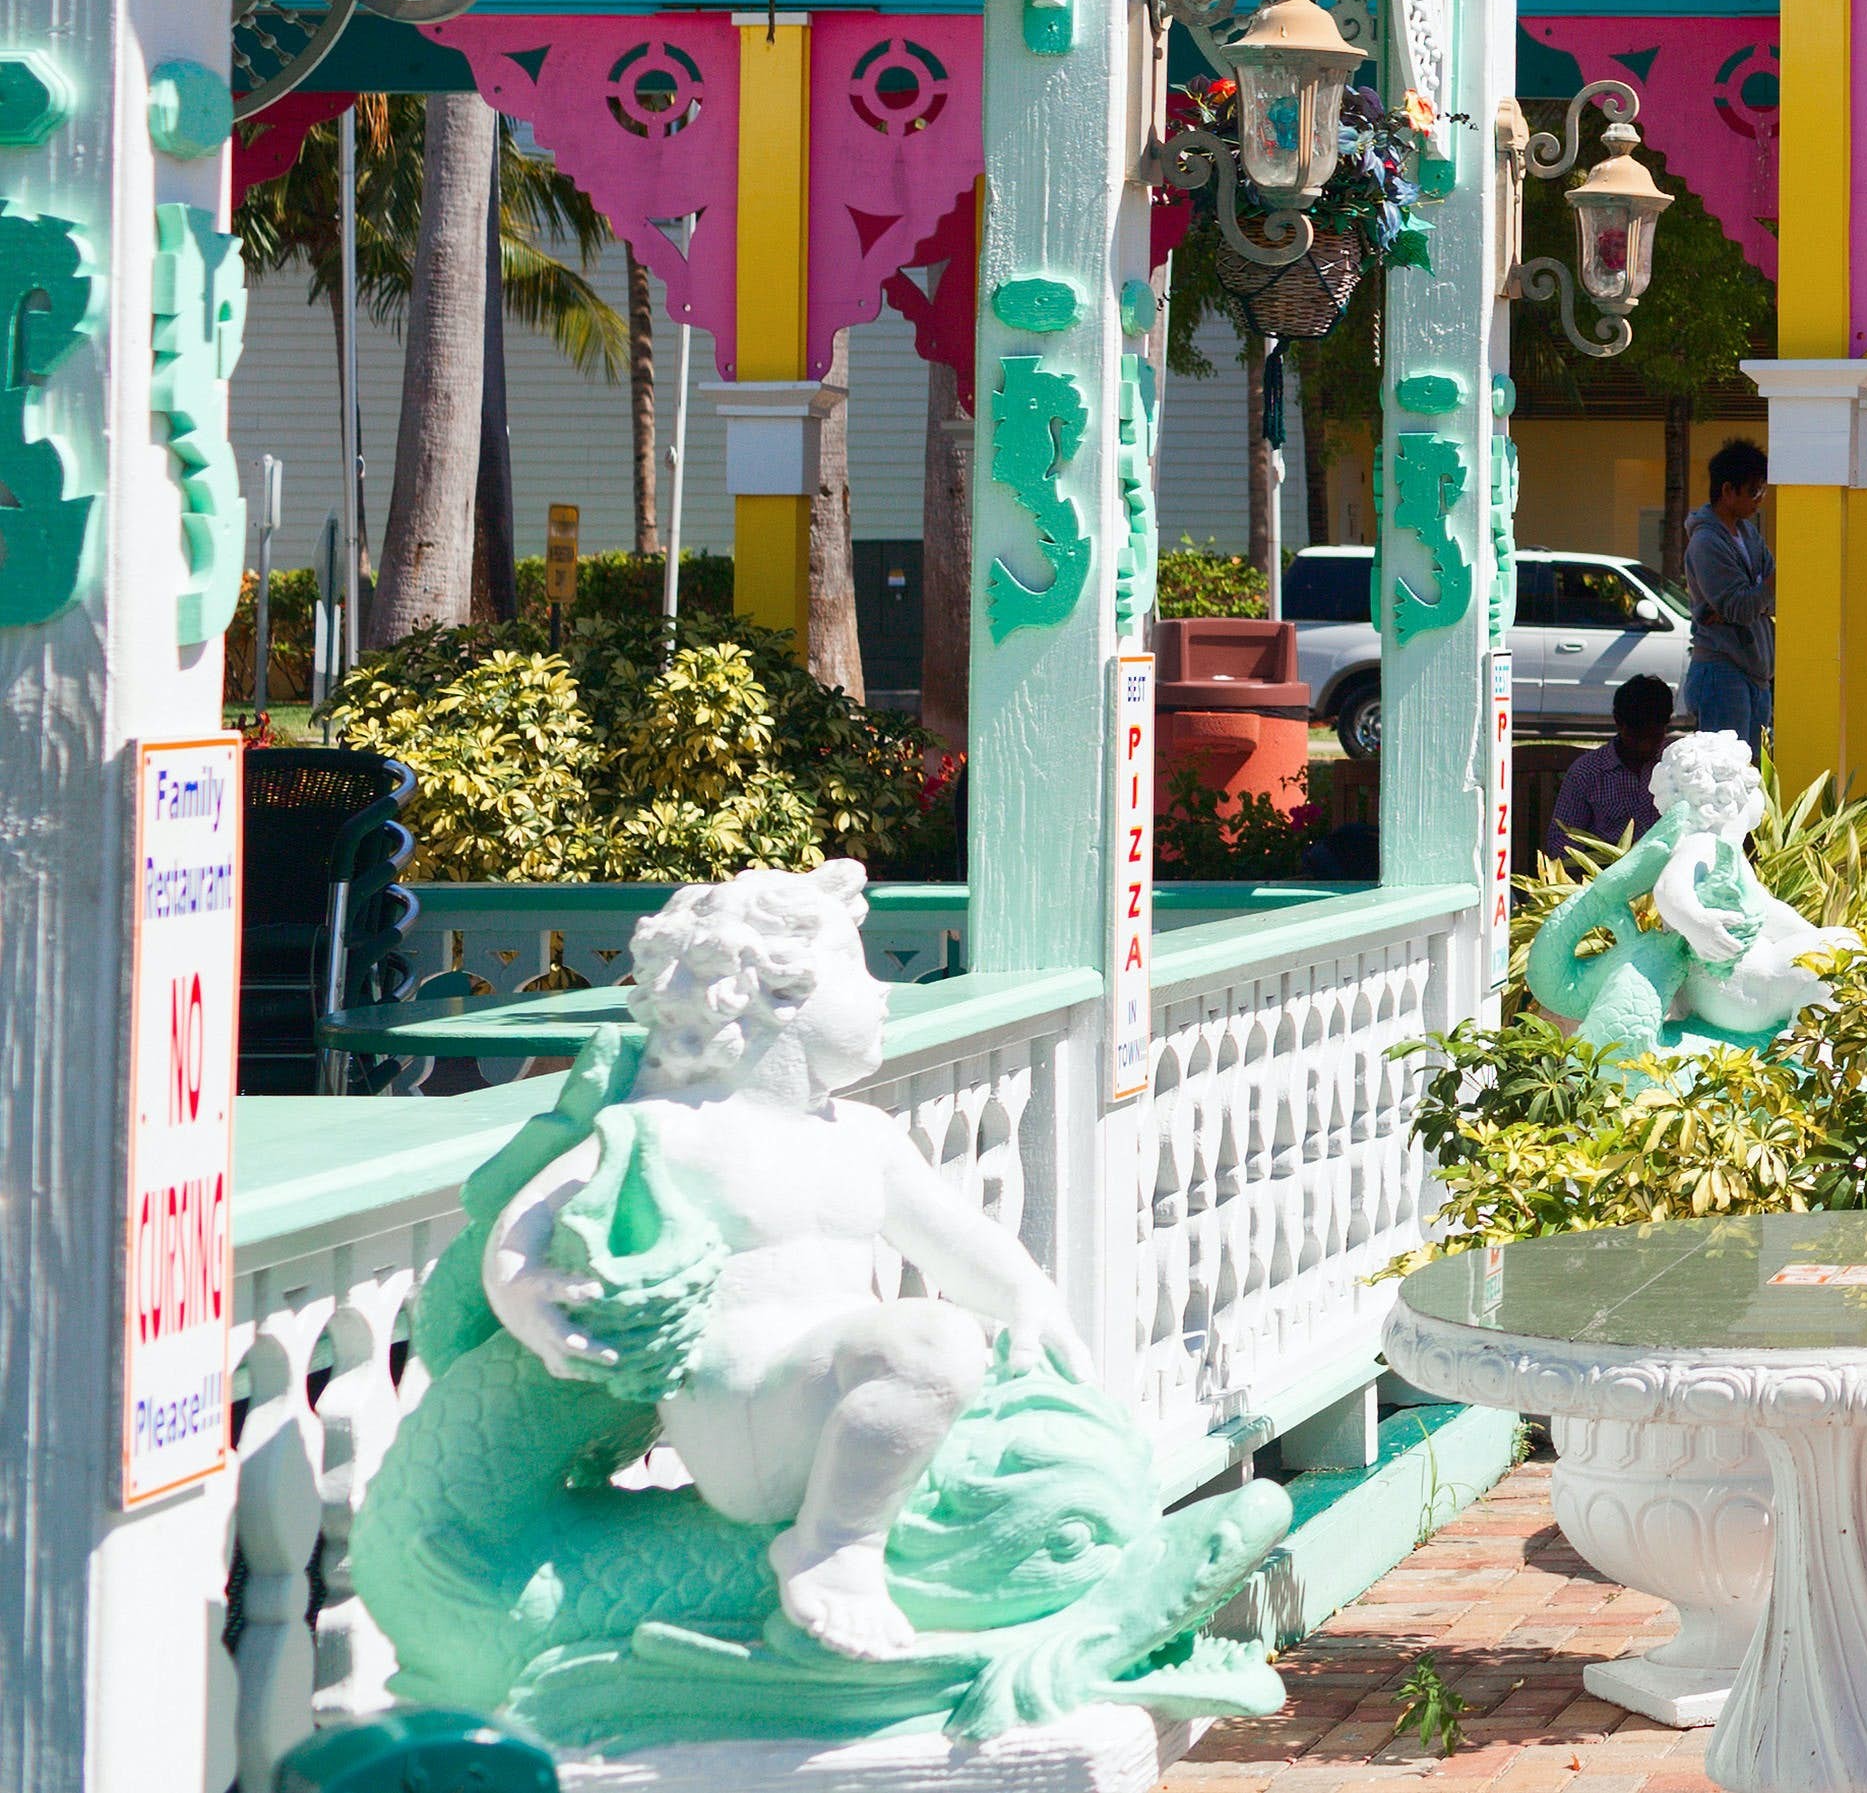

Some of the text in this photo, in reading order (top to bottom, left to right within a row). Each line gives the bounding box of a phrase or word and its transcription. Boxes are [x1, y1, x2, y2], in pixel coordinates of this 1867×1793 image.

[156, 768, 224, 833] Family
[1125, 723, 1143, 973] PIZZA
[1494, 710, 1508, 927] PIZZA
[146, 856, 233, 918] Restaurant
[168, 971, 202, 1126] NO
[138, 1172, 224, 1345] CURSING
[134, 1370, 222, 1457] Please!!!
